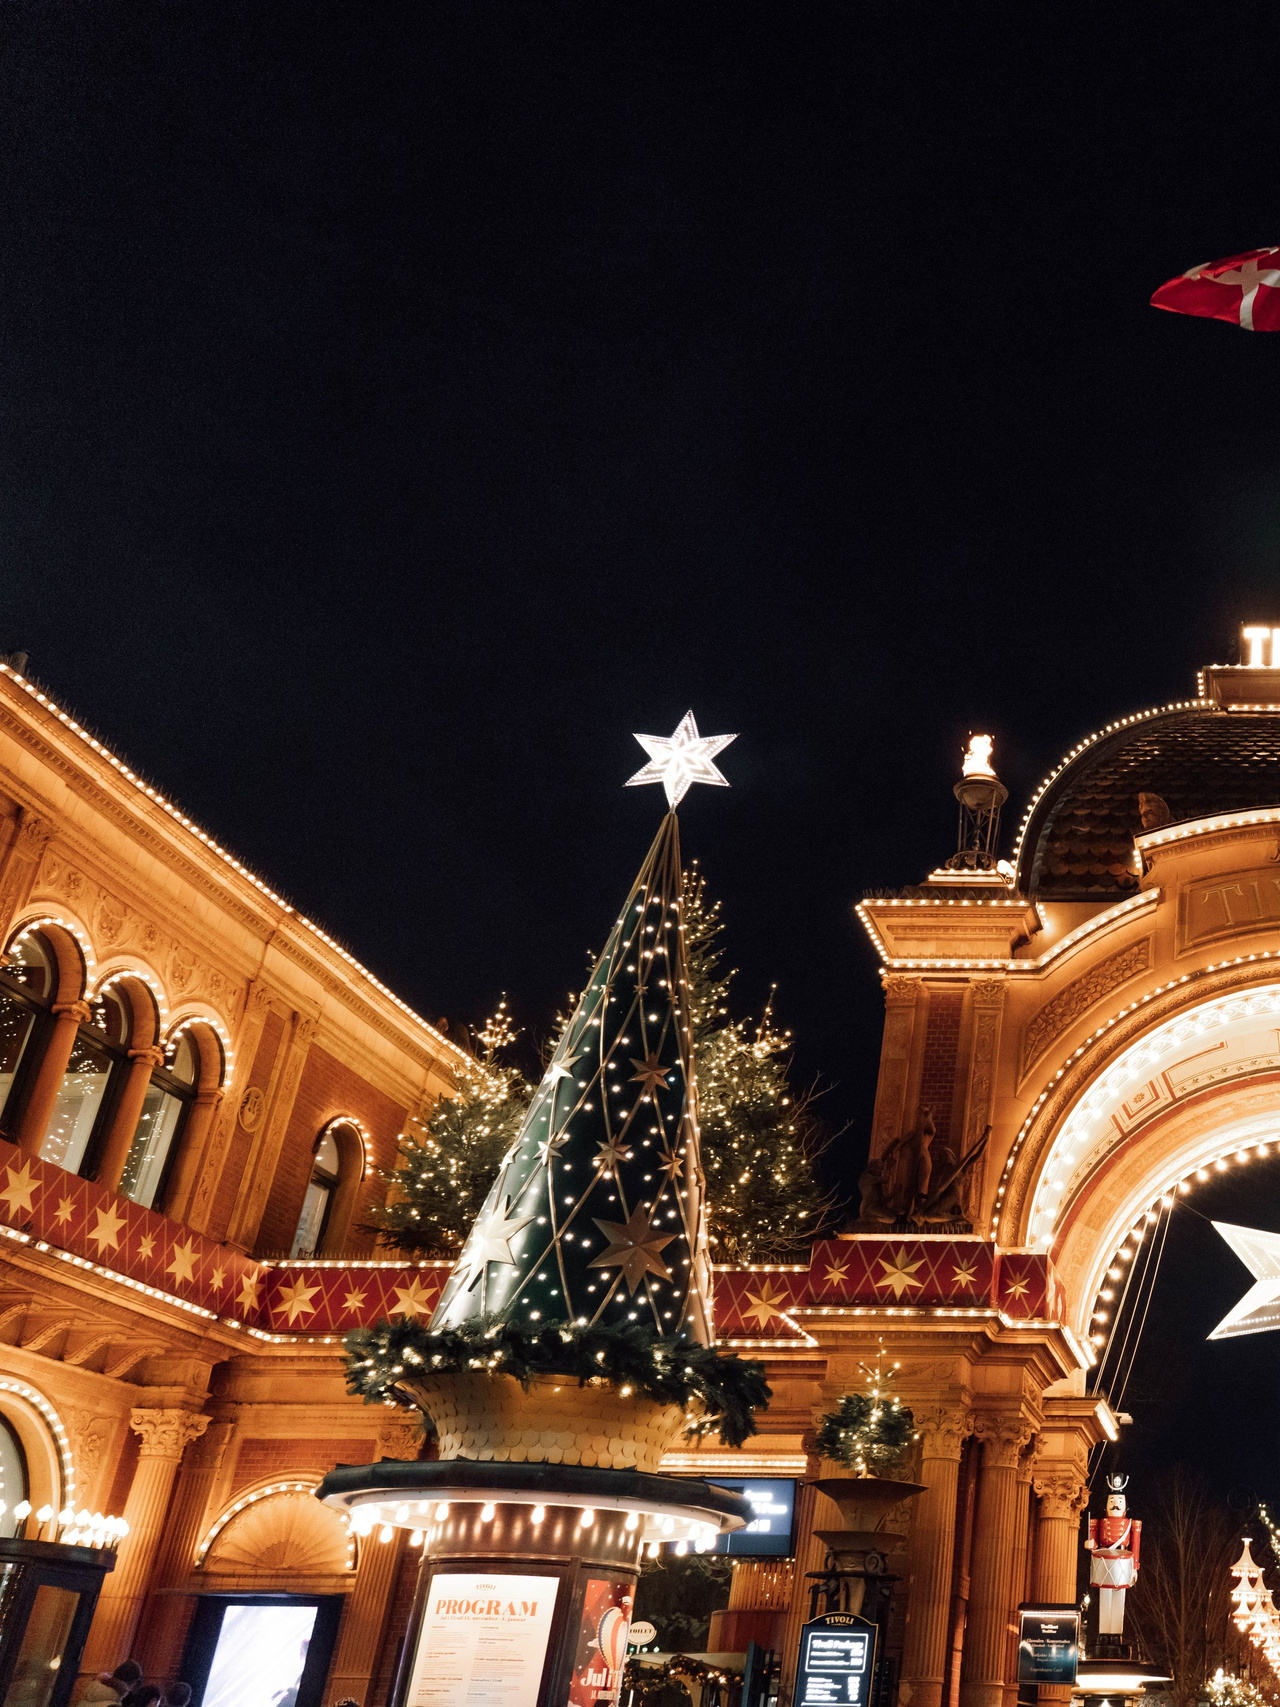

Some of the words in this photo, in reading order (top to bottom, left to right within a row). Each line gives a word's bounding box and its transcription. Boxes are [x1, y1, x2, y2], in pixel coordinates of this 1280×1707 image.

[435, 1599, 538, 1616] PROGRAM
[825, 1616, 854, 1625] TIVOLI
[580, 1668, 608, 1687] Jul
